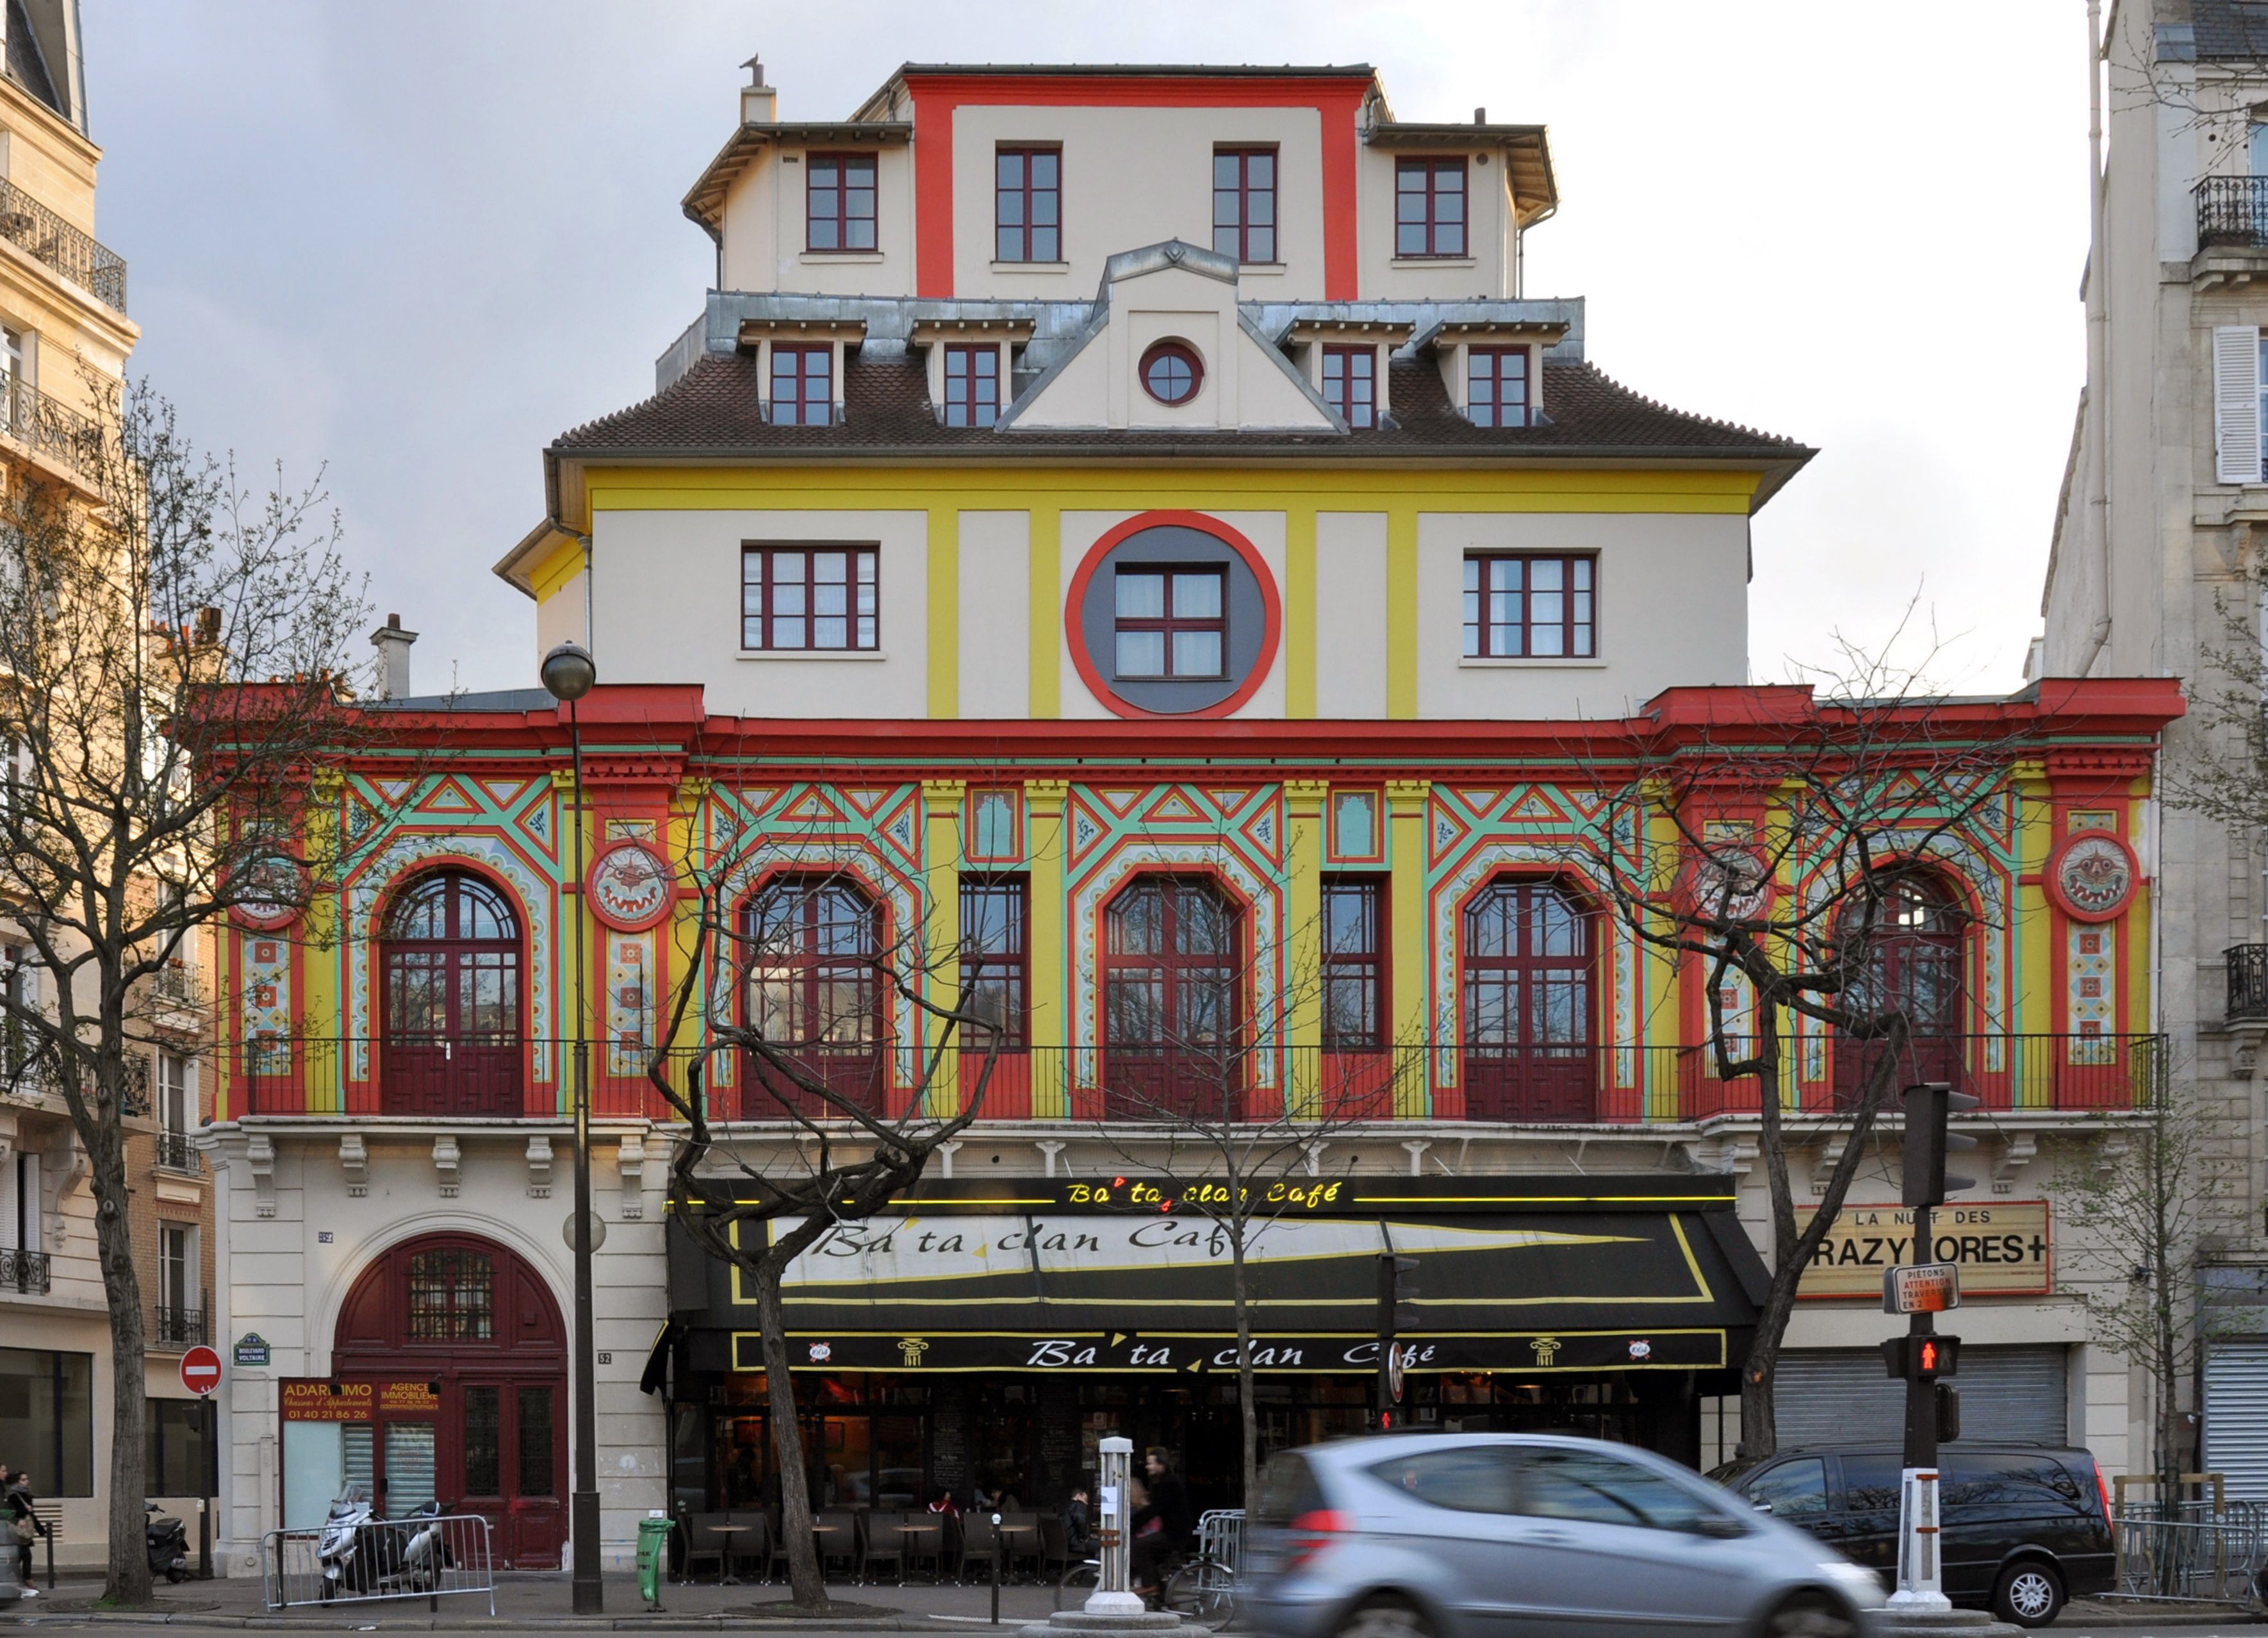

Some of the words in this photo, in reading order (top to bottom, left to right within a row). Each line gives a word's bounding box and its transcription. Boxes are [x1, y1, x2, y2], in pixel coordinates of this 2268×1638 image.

[1067, 1183, 1110, 1203] Ba
[1131, 1182, 1162, 1203] ta
[1266, 1182, 1343, 1208] Café
[1855, 1212, 1878, 1225] LA
[1894, 1212, 1939, 1225] NUT
[1955, 1210, 1991, 1224] DES
[810, 1225, 894, 1257] Ba
[917, 1230, 964, 1253] ta
[1907, 1268, 1945, 1279] PIÉTONS
[1904, 1278, 1952, 1289] ATTENTION
[599, 1354, 611, 1363] 52
[1026, 1340, 1096, 1367] Ba
[1130, 1344, 1171, 1365] ta
[1343, 1342, 1436, 1369] Cfé
[390, 1383, 429, 1391] AGENCE
[288, 1410, 300, 1419] 01
[304, 1410, 318, 1419] 40
[322, 1410, 333, 1419] 21
[336, 1410, 350, 1419] 86
[354, 1410, 367, 1419] 26
